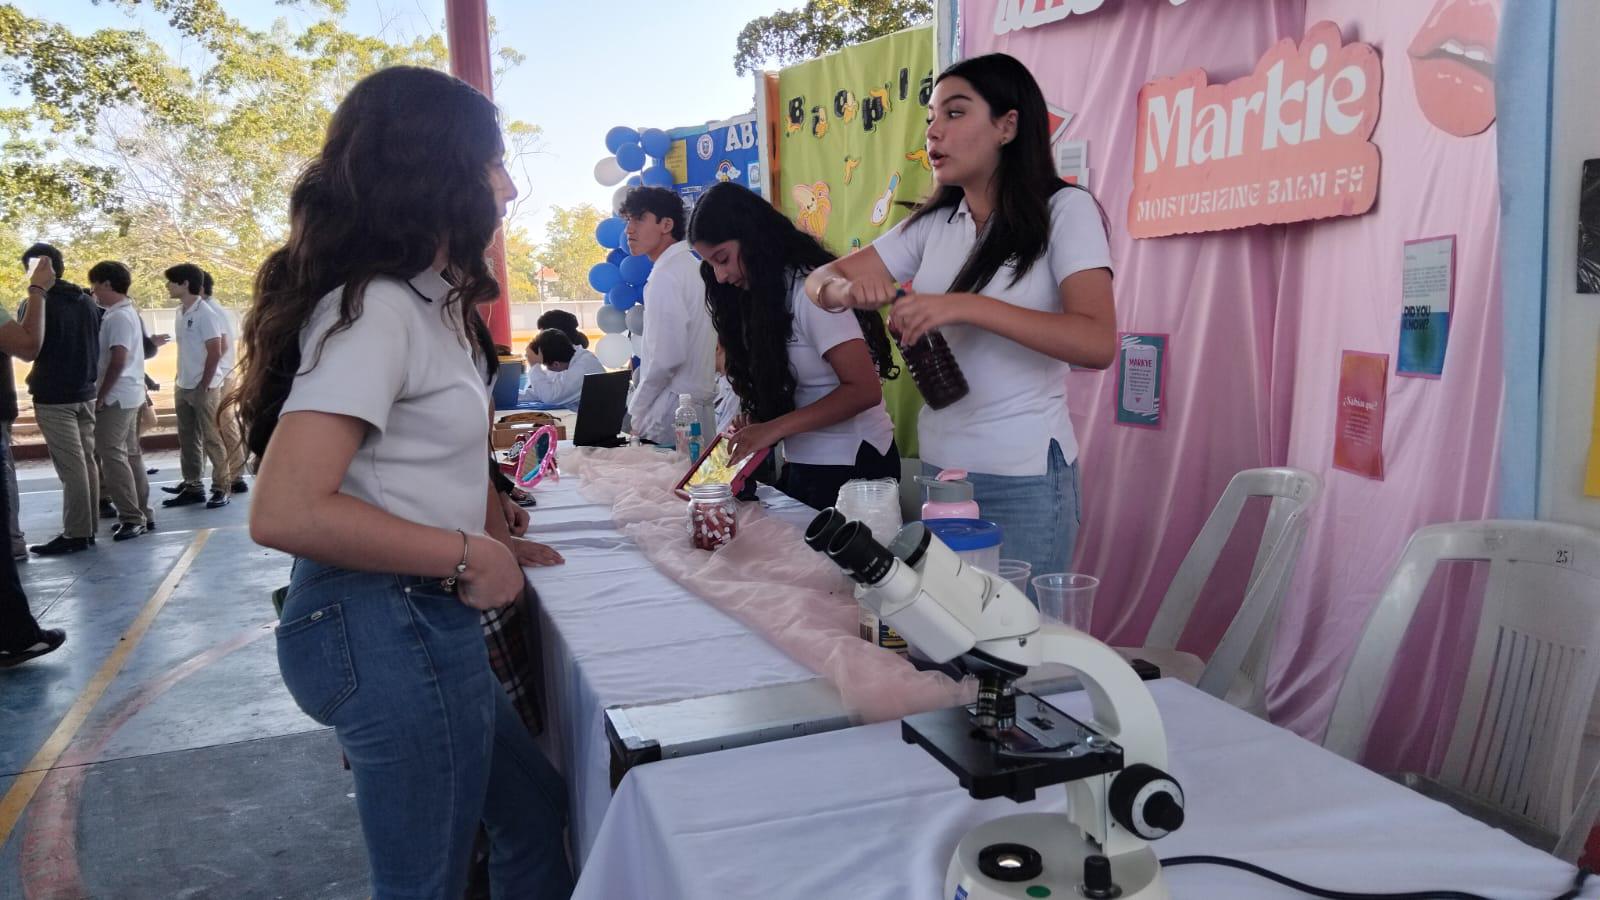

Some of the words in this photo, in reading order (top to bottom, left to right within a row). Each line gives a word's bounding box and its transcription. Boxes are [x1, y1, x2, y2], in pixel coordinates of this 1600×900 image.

[1144, 43, 1366, 174] Markie
[725, 121, 759, 151] AB
[1137, 183, 1261, 222] MOISTURIZING
[1267, 171, 1327, 205] BALM
[1334, 164, 1364, 195] PH
[1403, 305, 1416, 317] DID
[1416, 304, 1431, 317] YOU
[1556, 551, 1568, 563] 25
